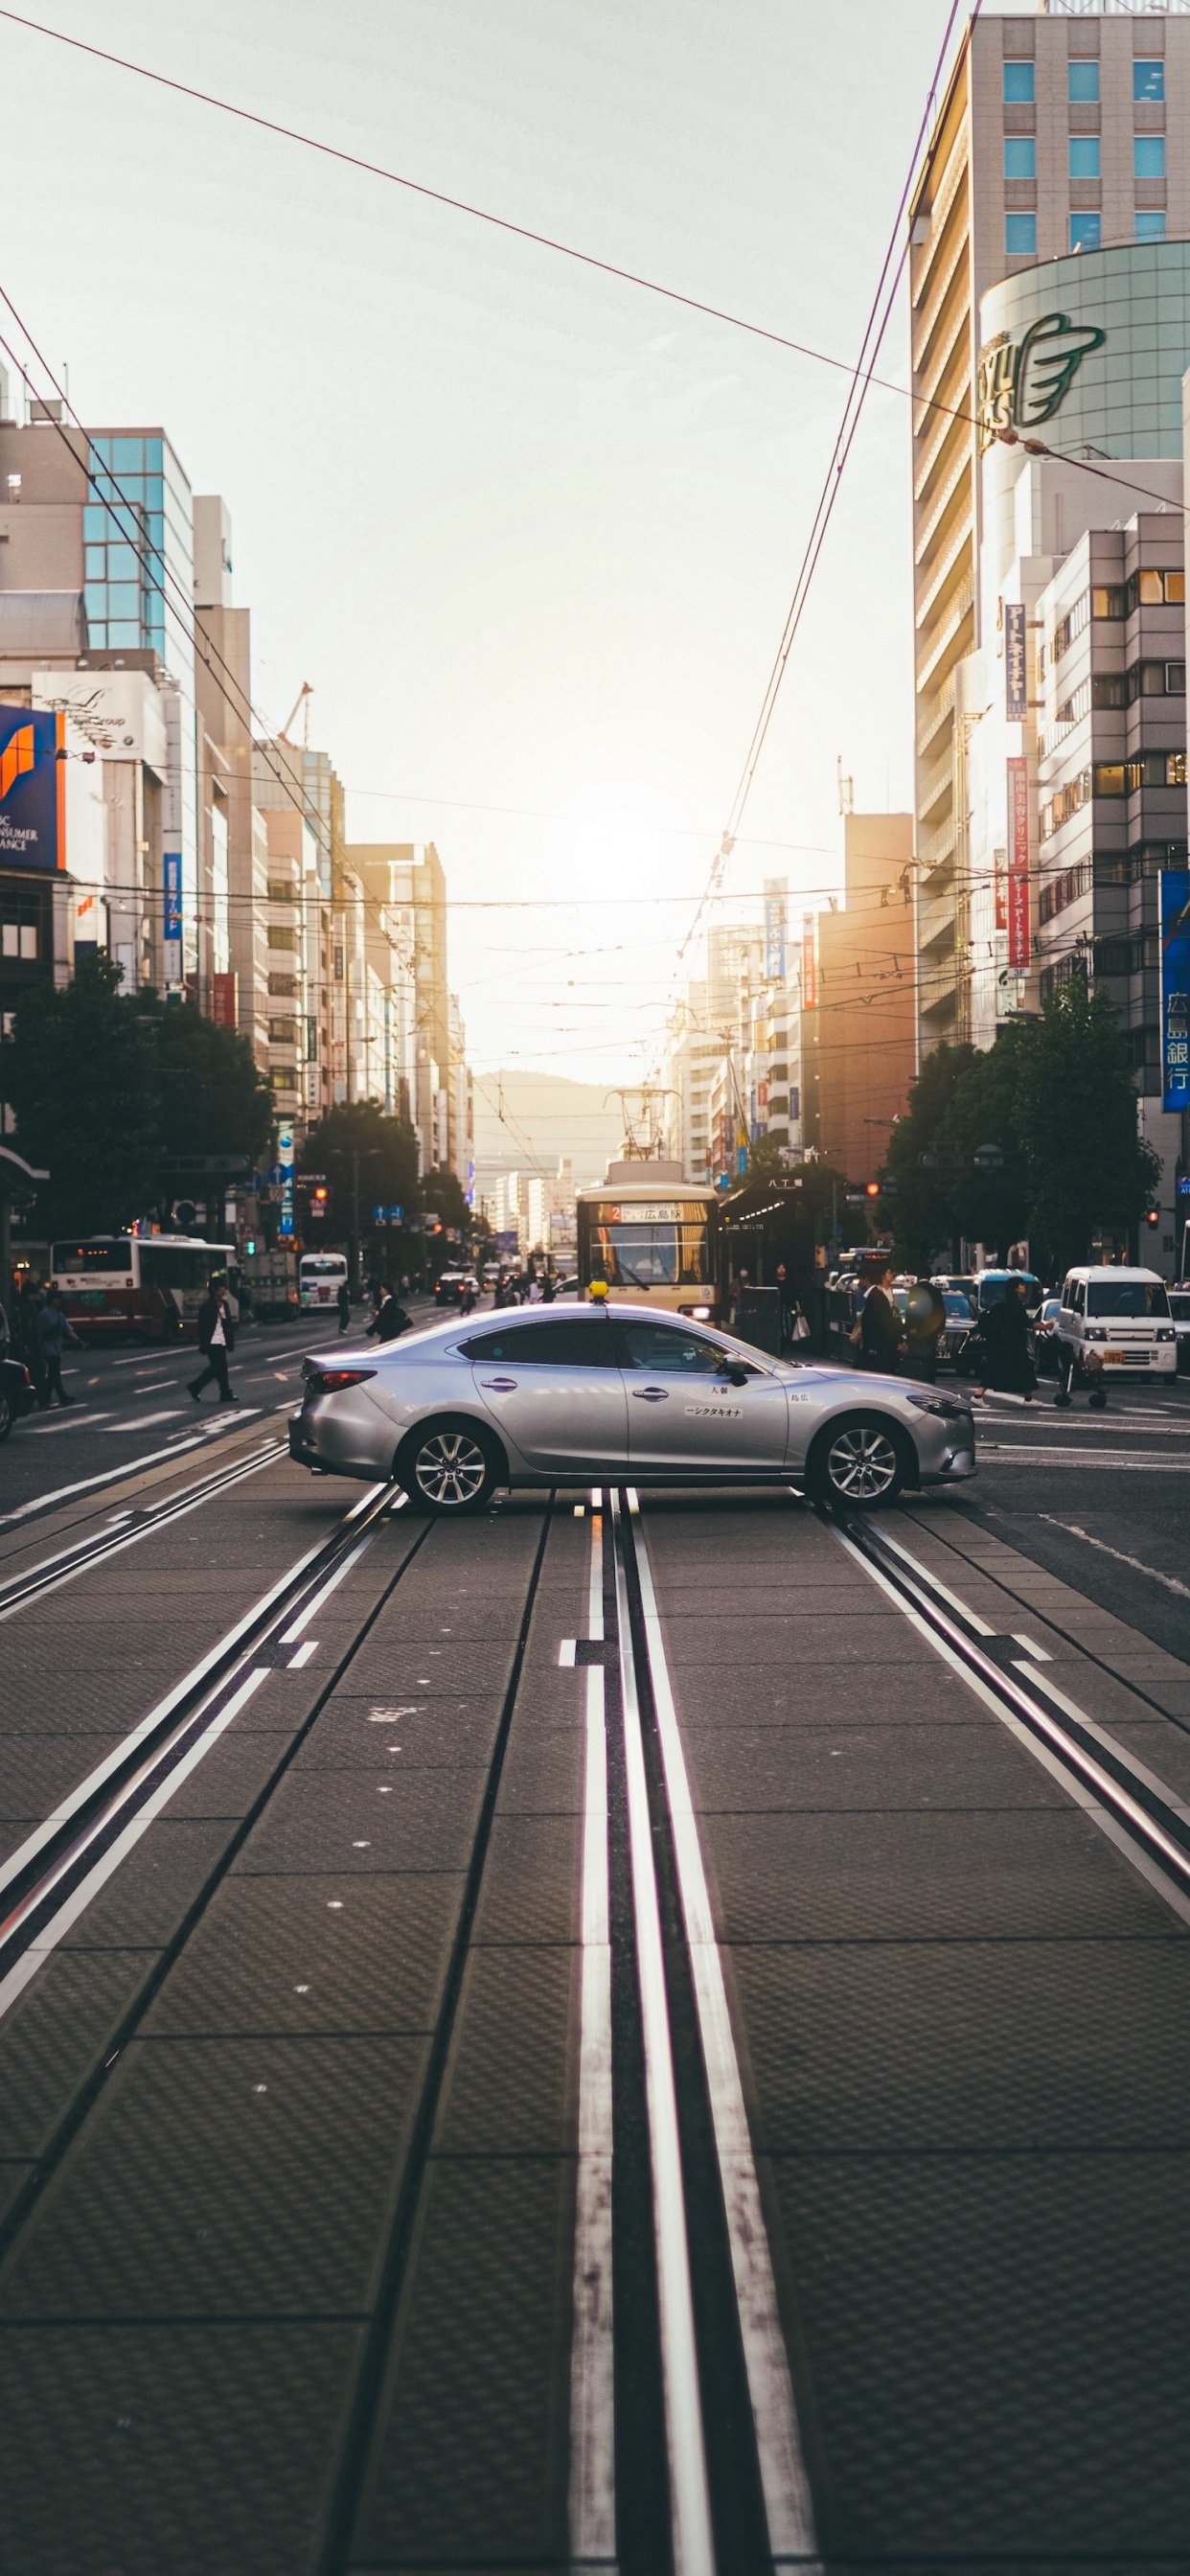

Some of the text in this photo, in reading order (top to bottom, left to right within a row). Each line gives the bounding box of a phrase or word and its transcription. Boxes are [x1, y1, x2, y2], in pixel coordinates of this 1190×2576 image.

[1007, 607, 1023, 701] アートネイチャー
[1014, 968, 1025, 978] 3F
[1167, 992, 1189, 1090] 広島銀行
[612, 1207, 621, 1220] 2
[645, 1209, 681, 1220] 広島駅
